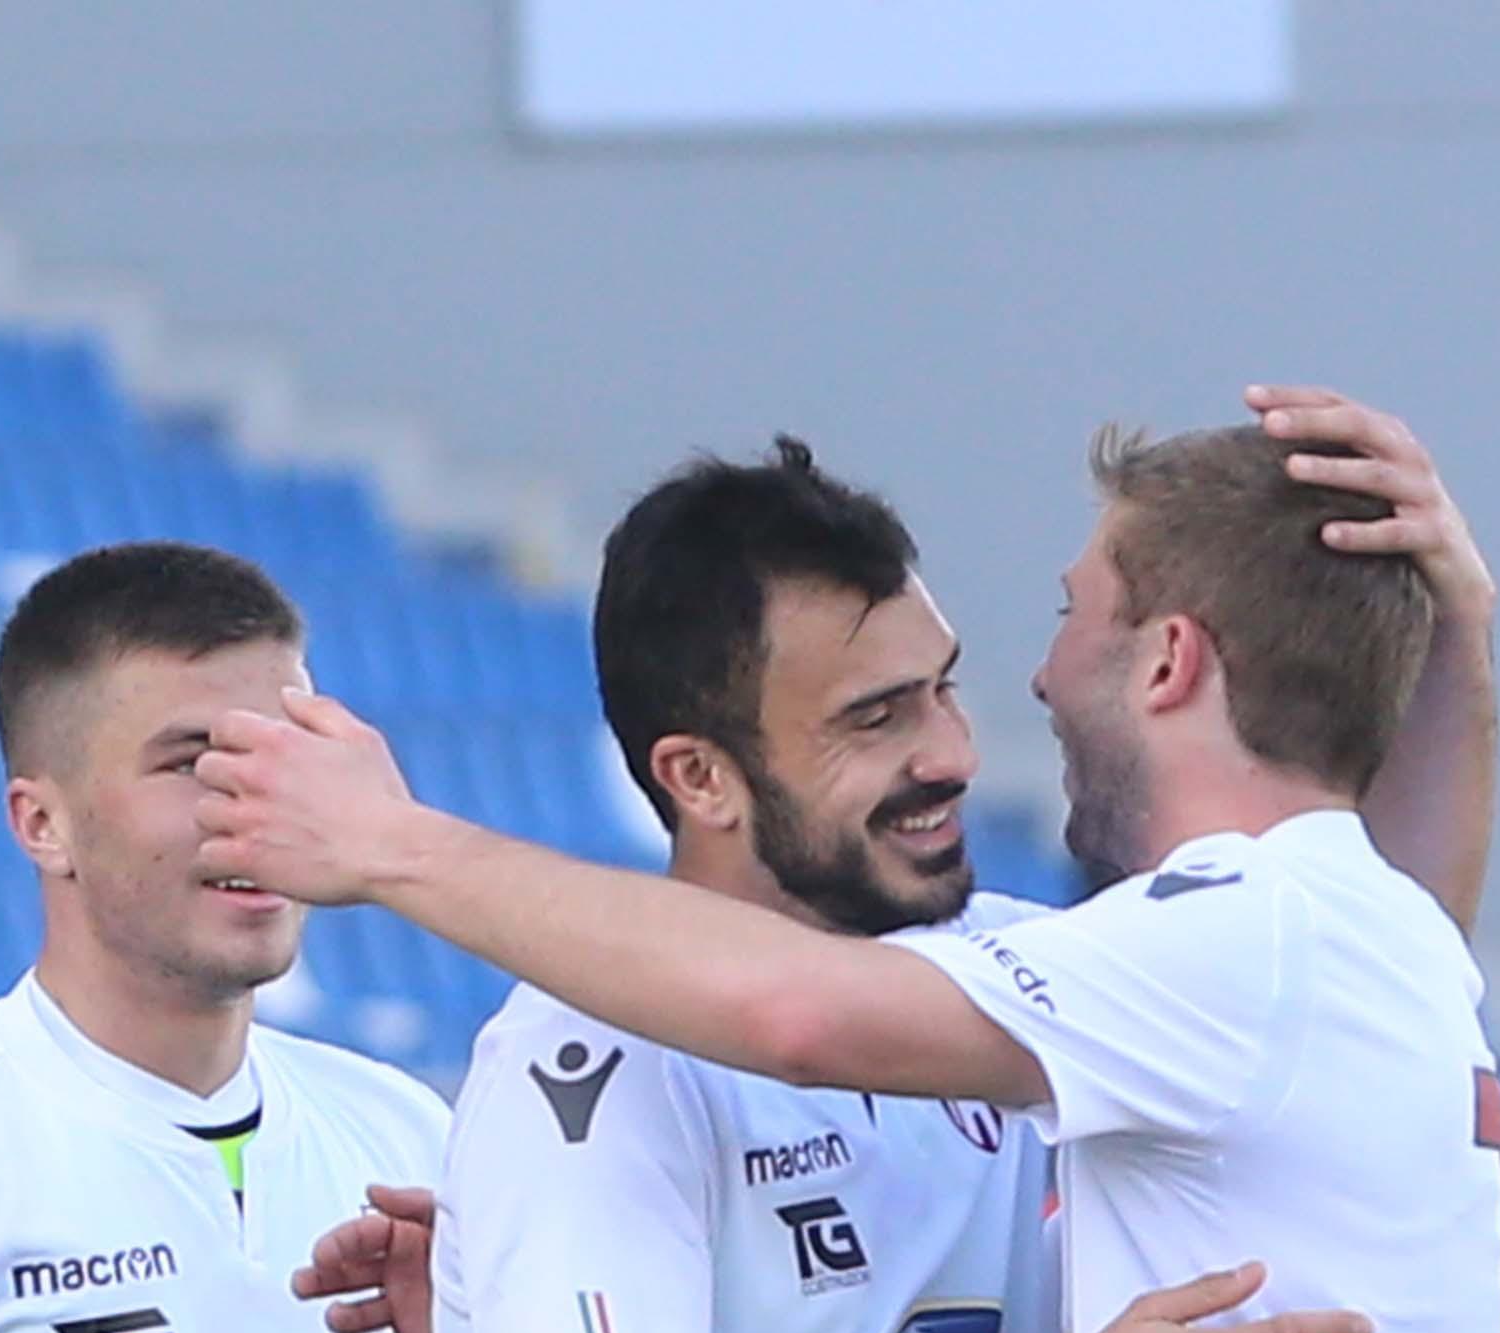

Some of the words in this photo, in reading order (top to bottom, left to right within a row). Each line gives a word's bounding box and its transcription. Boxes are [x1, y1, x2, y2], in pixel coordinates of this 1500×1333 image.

[744, 1132, 852, 1187] macron
[774, 1196, 868, 1280] TG
[12, 1242, 178, 1299] macron
